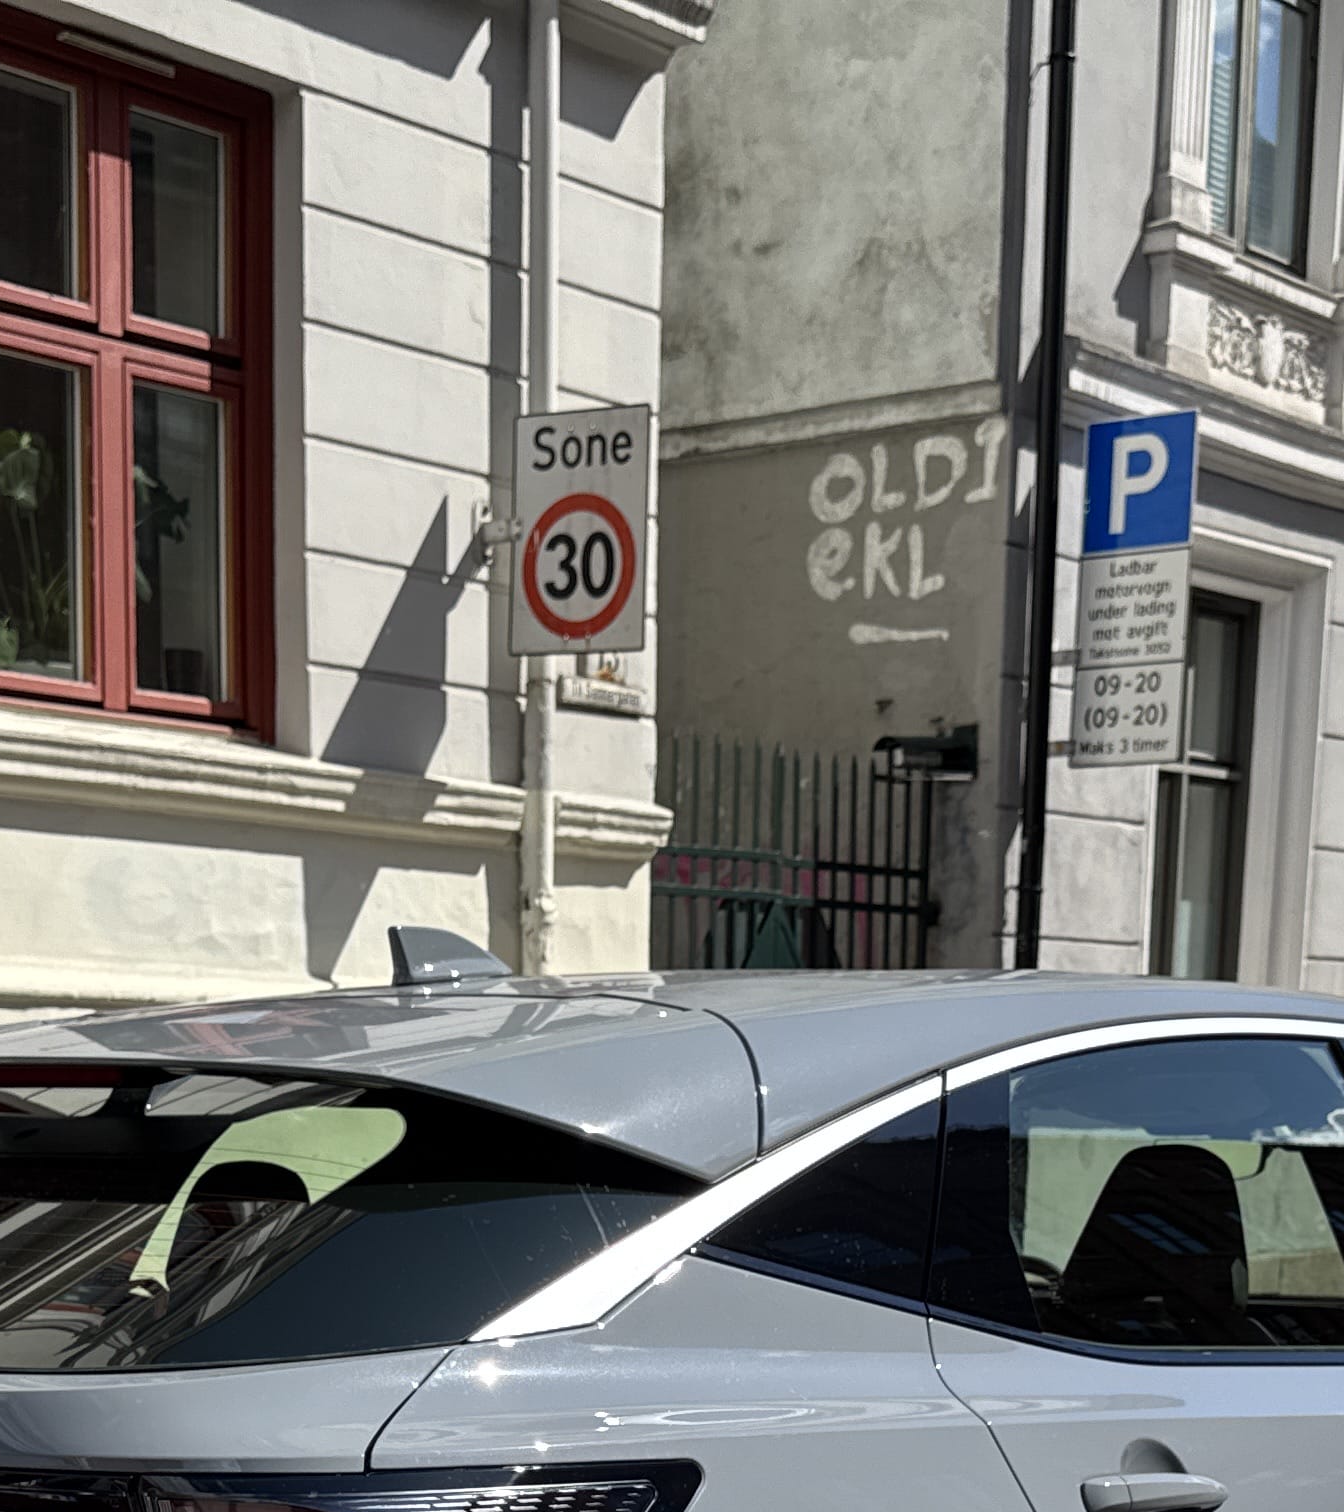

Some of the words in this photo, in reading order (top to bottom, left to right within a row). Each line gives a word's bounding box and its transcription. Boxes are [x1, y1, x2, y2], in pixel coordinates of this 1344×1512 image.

[532, 426, 632, 471] Sone
[1108, 432, 1170, 535] P
[543, 530, 615, 600] 30
[1109, 561, 1157, 578] Ladbar
[1088, 603, 1128, 621] under
[1134, 600, 1175, 618] lading
[1092, 626, 1120, 641] mot
[1127, 621, 1168, 641] avgift
[1079, 741, 1114, 754] Maks
[1119, 738, 1128, 754] 3
[1133, 736, 1169, 753] timer
